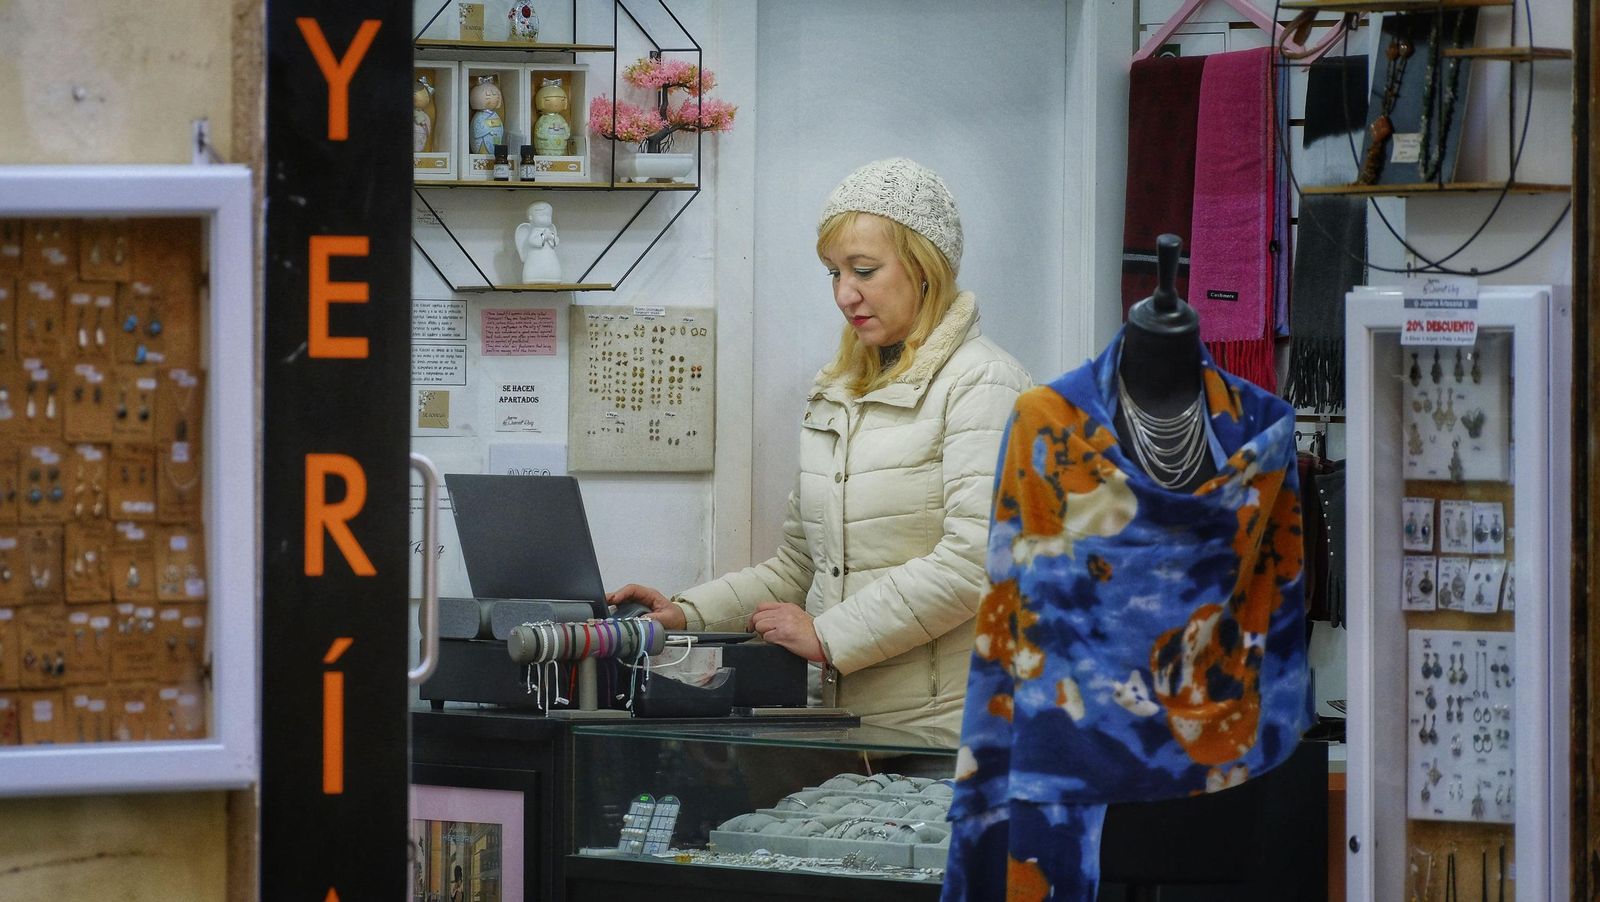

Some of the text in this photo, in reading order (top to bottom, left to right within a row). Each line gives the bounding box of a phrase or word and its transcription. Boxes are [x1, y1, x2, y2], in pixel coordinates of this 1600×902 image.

[296, 17, 383, 902] YERÍ
[1406, 320, 1475, 332] 20% DESCUENTO
